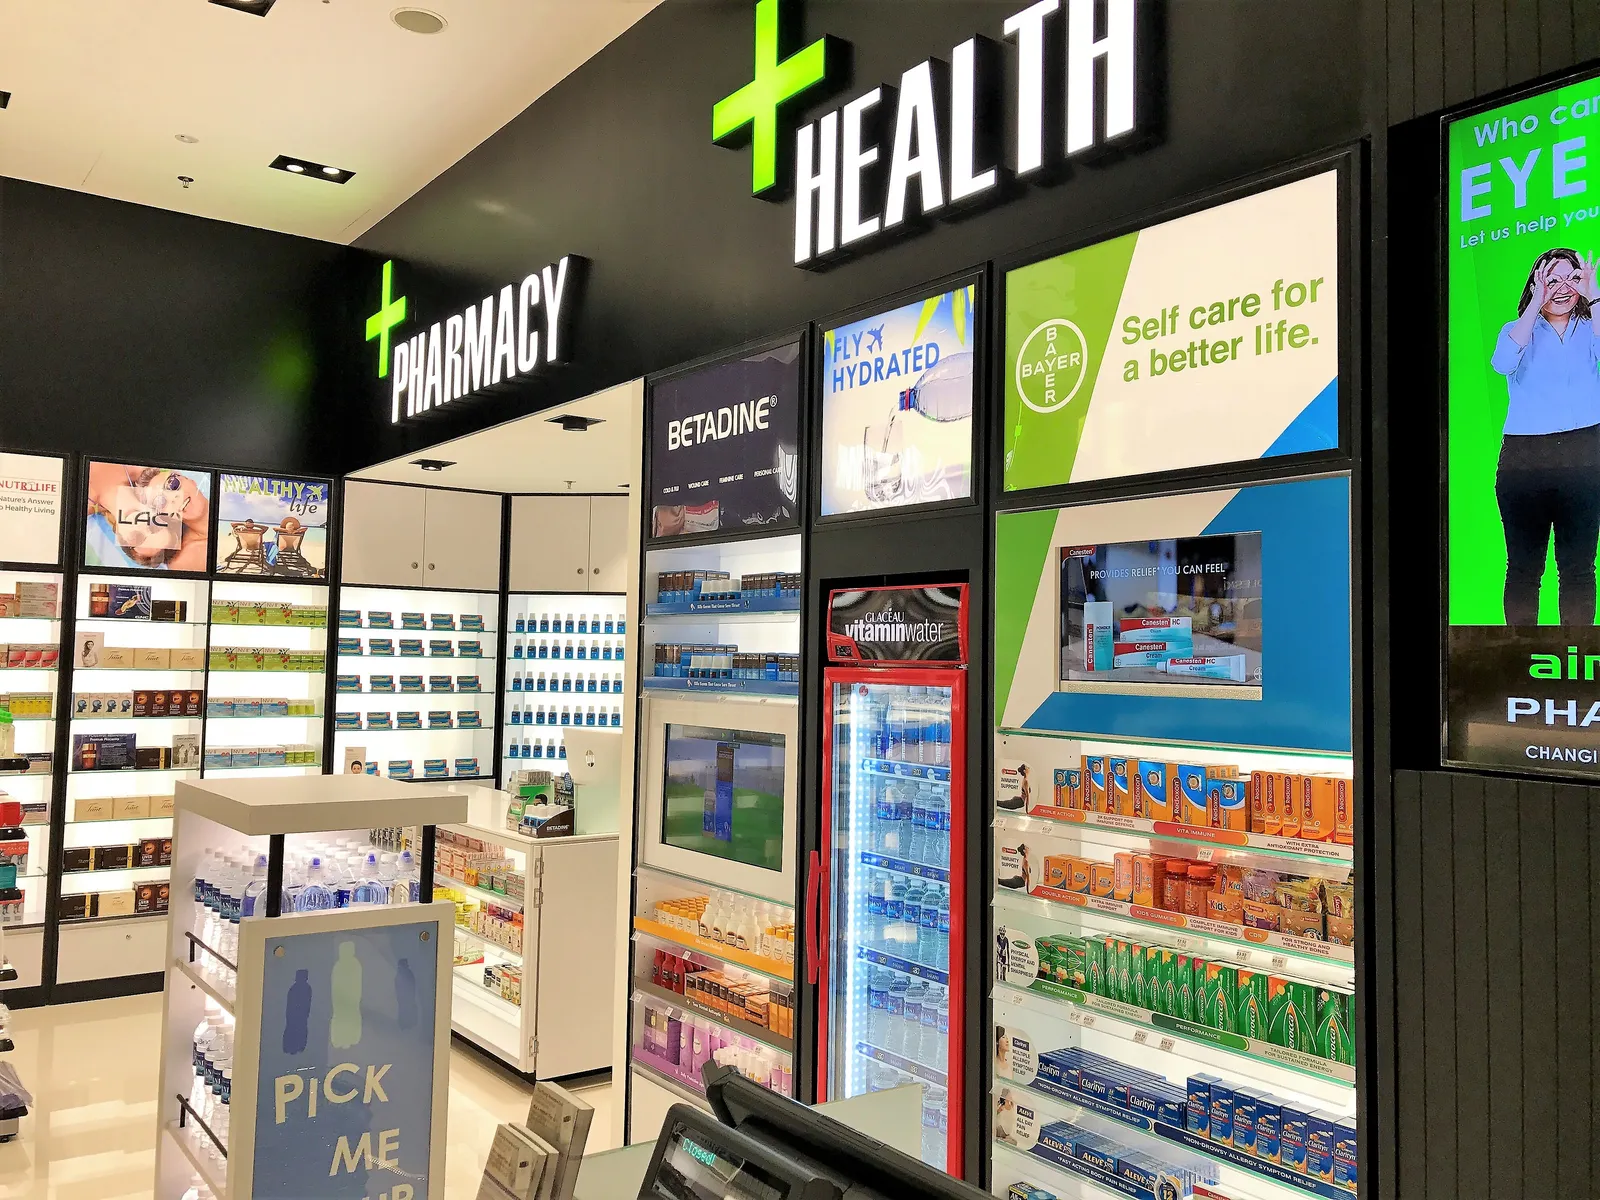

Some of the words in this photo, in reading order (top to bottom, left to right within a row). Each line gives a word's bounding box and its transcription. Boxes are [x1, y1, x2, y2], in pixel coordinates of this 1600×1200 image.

[794, 0, 1135, 263] HEALTH
[1474, 115, 1539, 147] Who
[1461, 136, 1587, 222] EYE
[1460, 230, 1486, 249] Let
[1490, 226, 1510, 241] us
[1516, 215, 1557, 235] help
[1122, 304, 1180, 345] Self
[1189, 292, 1261, 329] care
[1271, 276, 1324, 311] for
[391, 256, 569, 424] PHARMACY
[833, 331, 864, 363] FLY
[1123, 359, 1139, 383] a
[1149, 335, 1243, 377] better
[1255, 319, 1319, 356] life.
[832, 342, 940, 394] HYDRATED
[1021, 351, 1081, 378] BAYER
[1044, 326, 1058, 404] BAYER
[223, 477, 305, 499] HEALTHY
[27, 497, 54, 506] Answer
[289, 494, 318, 516] life
[5, 505, 33, 514] Healthy
[34, 506, 55, 515] Living
[117, 508, 169, 527] LAC
[1069, 548, 1094, 556] Canesten
[1090, 568, 1129, 580] PROVIDES
[1161, 565, 1180, 575] YOU
[1182, 564, 1203, 575] CAN
[1205, 563, 1225, 573] FEEL
[865, 608, 905, 623] GLACÉAU
[1141, 618, 1170, 626] Canesten
[1171, 618, 1181, 626] HC
[844, 618, 944, 642] vitaminwater
[1135, 643, 1165, 651] Canesten
[1525, 745, 1598, 764] CHANGI
[1056, 810, 1075, 819] ACTION
[1190, 830, 1216, 838] IMMUNE
[1267, 843, 1303, 852] ANTIOXIDANT
[1303, 848, 1340, 857] PROTECTION
[1041, 890, 1061, 898] DOUBLE
[1062, 894, 1080, 902] ACTION
[1097, 904, 1117, 912] SUPPORT
[1209, 900, 1228, 912] Kids
[1150, 912, 1177, 922] GUMMIES
[1189, 919, 1216, 928] COMPLETE
[1216, 923, 1239, 932] IMMUNE
[1190, 923, 1212, 931] SUPPORT
[1282, 941, 1308, 951] HEALTHY
[1308, 946, 1329, 955] BONES
[1294, 938, 1316, 948] STRONG
[1041, 985, 1078, 999] PERFORMANCE
[1101, 1003, 1125, 1015] SUSTAINED
[1117, 1003, 1138, 1013] FORMULA
[1176, 1024, 1221, 1040] PERFORMANCE
[1013, 1048, 1031, 1059] MULTIPLE
[1270, 1047, 1298, 1059] TAILORED
[1298, 1056, 1327, 1067] FORMULA
[1013, 1061, 1034, 1073] SYMPTOMS
[1038, 1062, 1060, 1076] Clarityn
[1264, 1050, 1276, 1058] FOR
[1277, 1053, 1309, 1067] SUSTAINED
[1309, 1063, 1334, 1074] ENERGY
[1013, 1067, 1026, 1076] RELIEF
[1081, 1078, 1106, 1093] Clarityn
[274, 1063, 392, 1125] PICK
[1072, 1094, 1095, 1107] ALLERGY
[1095, 1101, 1122, 1117] SYMPTOM
[1122, 1112, 1141, 1123] RELIEF
[1130, 1095, 1155, 1111] Clarityn
[1187, 1101, 1205, 1111] Clarityn
[1211, 1107, 1229, 1118] Clarityn
[1016, 1123, 1026, 1131] PAIN
[1234, 1114, 1253, 1126] Clarityn
[1016, 1130, 1030, 1139] RELIEF
[1257, 1124, 1276, 1135] Clarityn
[1282, 1130, 1302, 1142] Clarityn
[1043, 1136, 1063, 1150] ALEVE
[1308, 1140, 1328, 1152] Clarityn
[329, 1128, 400, 1177] ME
[1082, 1152, 1104, 1167] ALEVE
[1335, 1149, 1357, 1161] Clarityn
[1228, 1150, 1258, 1166] ALLERGY
[1258, 1162, 1292, 1180] SYMPTOM
[1292, 1176, 1317, 1188] RELIEF
[1071, 1162, 1090, 1174] ACTING
[1090, 1170, 1105, 1180] BODY
[1105, 1176, 1118, 1185] PAIN
[1118, 1181, 1137, 1193] RELIEF
[1124, 1169, 1146, 1184] ALEVE
